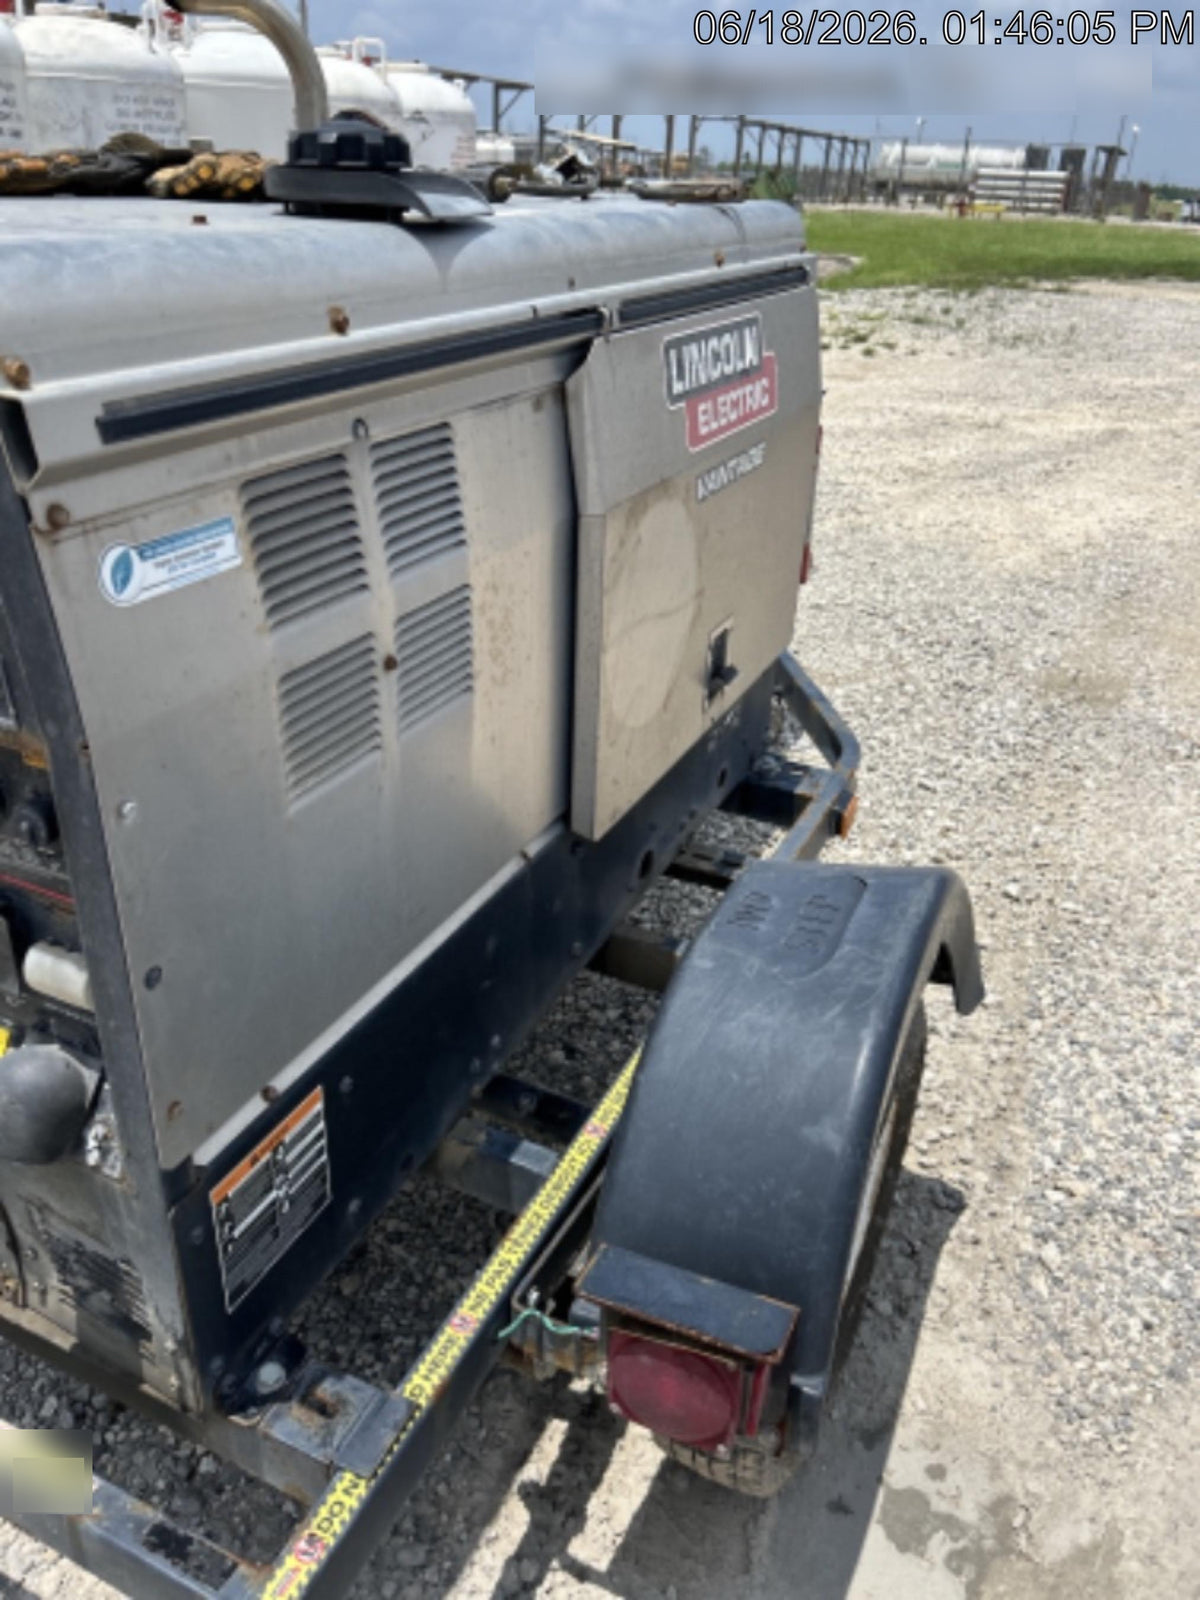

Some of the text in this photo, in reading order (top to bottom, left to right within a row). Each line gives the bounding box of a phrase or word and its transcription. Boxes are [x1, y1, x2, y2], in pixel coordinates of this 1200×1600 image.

[669, 325, 760, 396] LINCOLN
[697, 377, 770, 436] ELECTRIC
[485, 1259, 512, 1290] PAS
